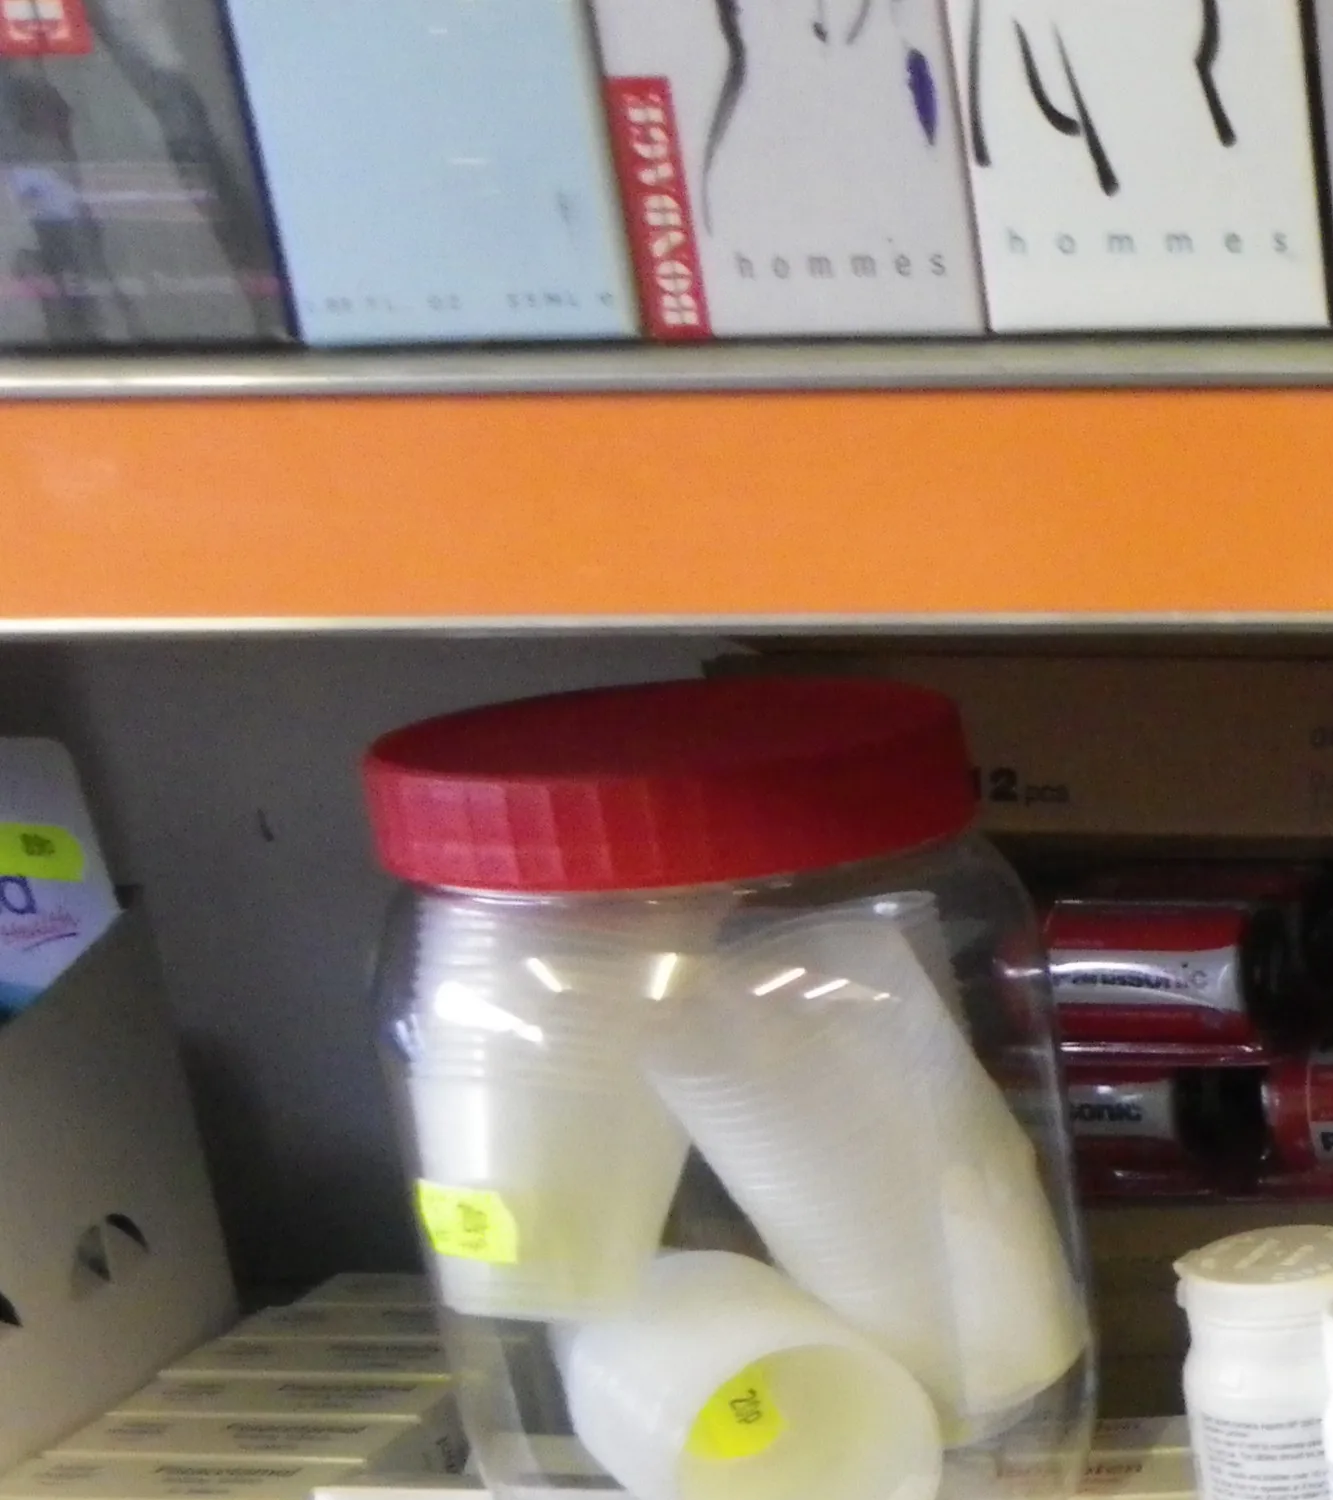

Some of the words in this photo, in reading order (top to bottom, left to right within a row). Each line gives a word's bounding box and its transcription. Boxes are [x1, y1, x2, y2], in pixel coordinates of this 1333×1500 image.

[623, 93, 699, 326] BONDAGE
[1005, 229, 1292, 256] hommes
[735, 251, 945, 279] hommes
